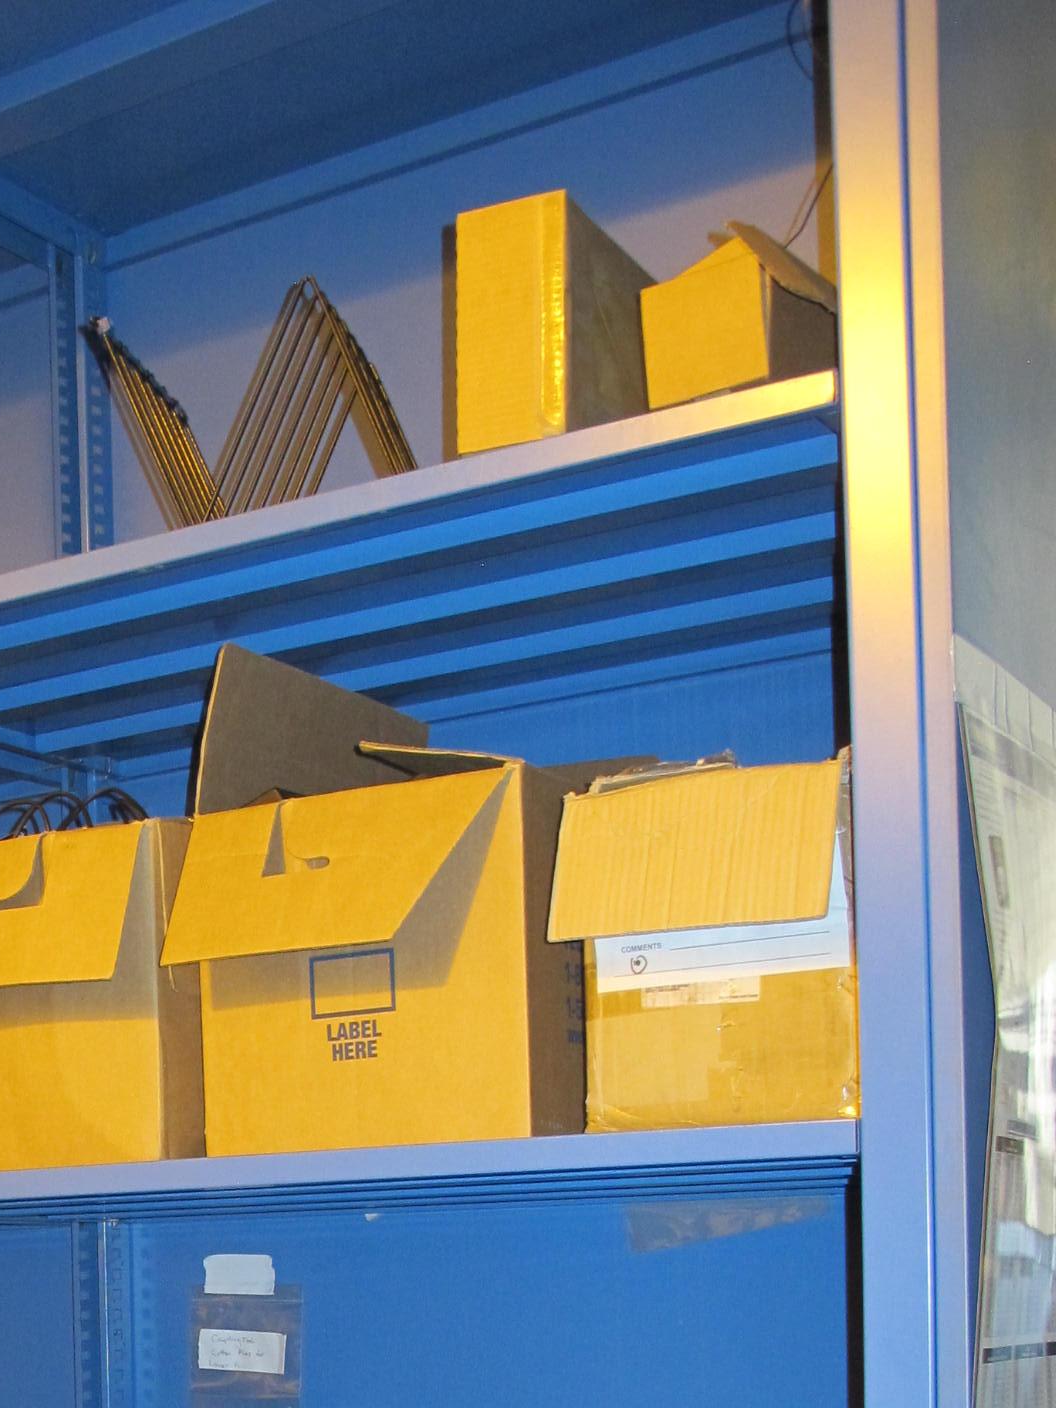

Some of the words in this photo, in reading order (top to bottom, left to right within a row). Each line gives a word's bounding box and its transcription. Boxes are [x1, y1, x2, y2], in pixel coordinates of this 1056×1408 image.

[621, 942, 662, 954] COMMENTS
[326, 1019, 382, 1042] LABEL
[332, 1040, 378, 1062] HERE
